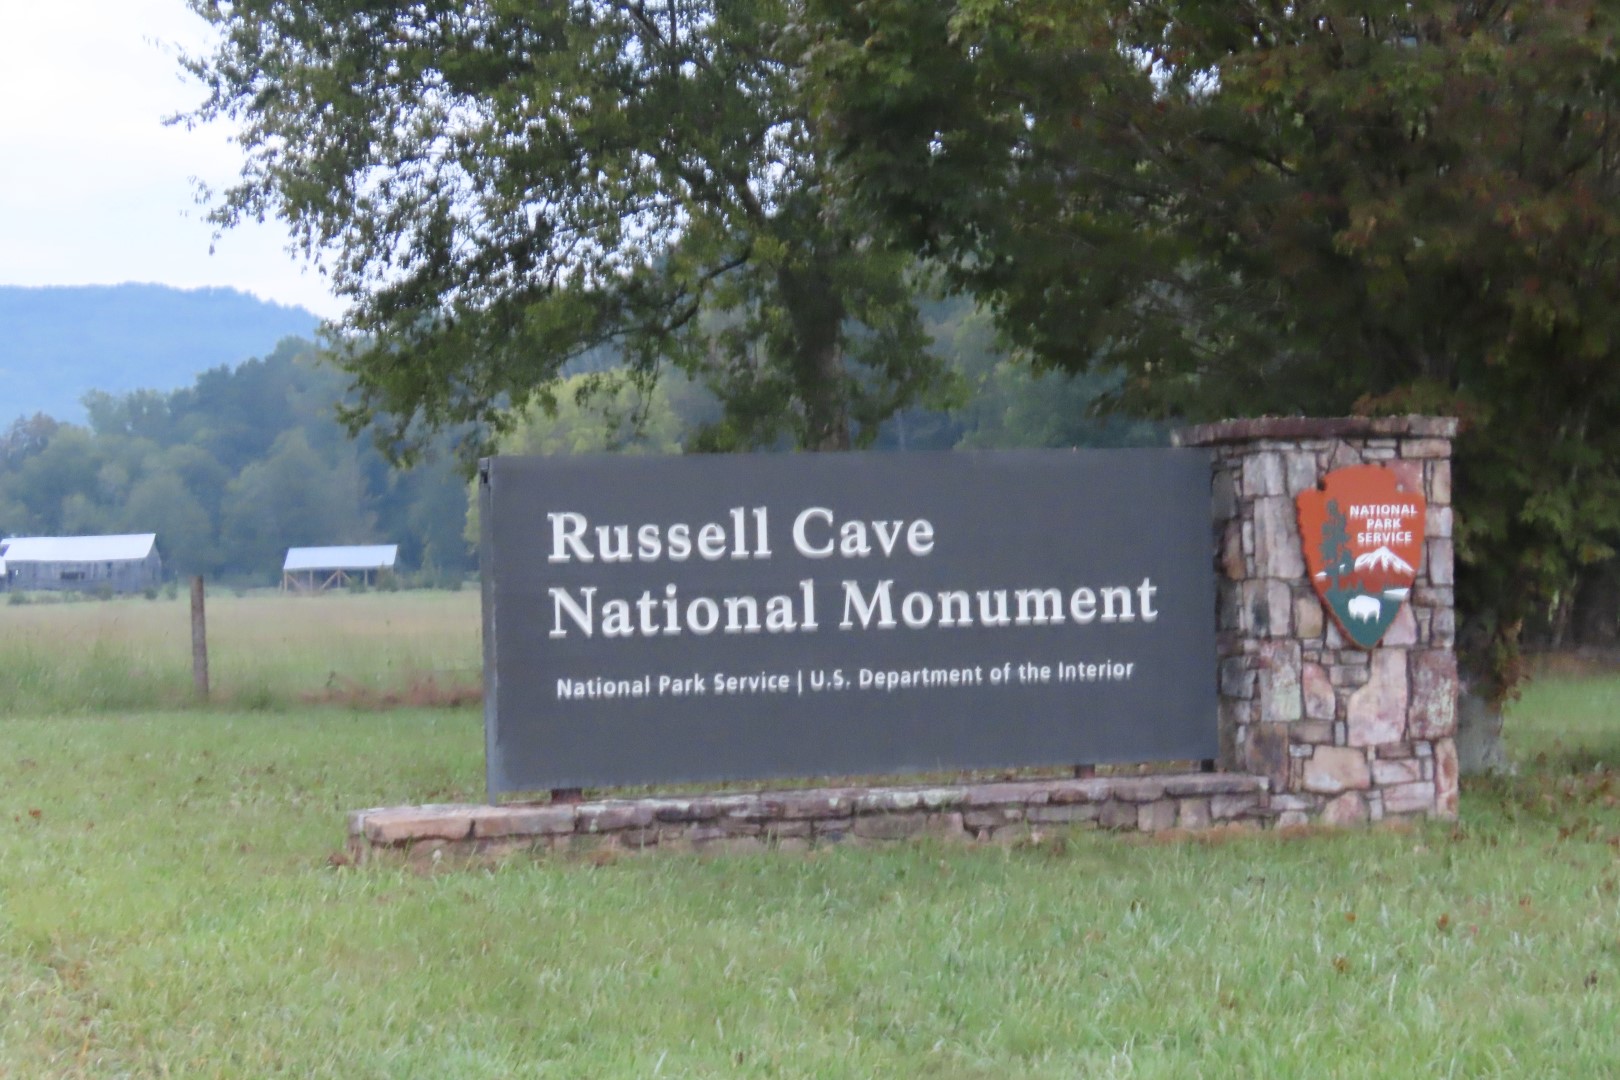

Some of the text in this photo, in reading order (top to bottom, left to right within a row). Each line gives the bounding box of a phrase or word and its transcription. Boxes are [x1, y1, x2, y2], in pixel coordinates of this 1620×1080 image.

[1349, 504, 1418, 517] NATIONAL
[547, 506, 935, 563] Russell Cave
[1357, 531, 1412, 544] SERVICE
[1366, 518, 1402, 531] PARK
[548, 577, 1159, 638] National Monument
[556, 675, 651, 699] National
[658, 673, 706, 695] Park
[713, 674, 790, 693] Service
[810, 669, 853, 690] U.S.
[859, 666, 983, 692] Department
[989, 662, 1012, 684] of
[1018, 661, 1051, 683] the
[1058, 659, 1135, 682] Interior
